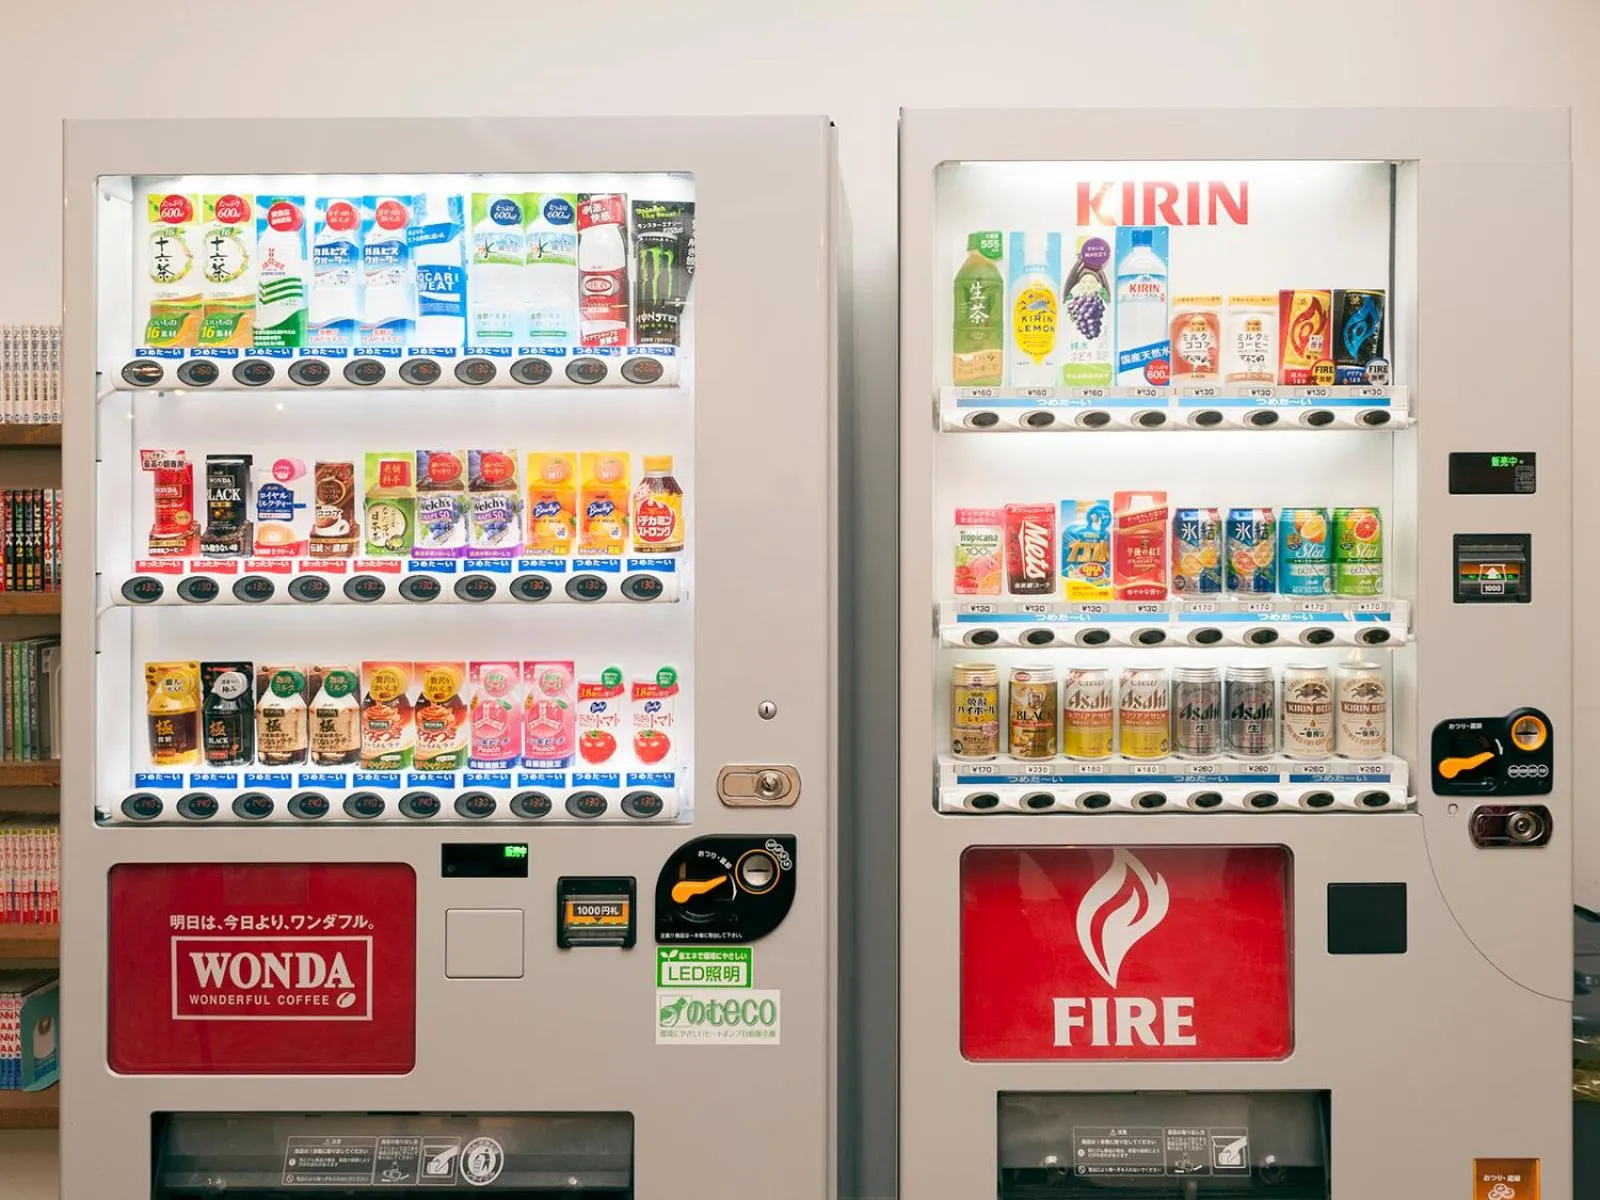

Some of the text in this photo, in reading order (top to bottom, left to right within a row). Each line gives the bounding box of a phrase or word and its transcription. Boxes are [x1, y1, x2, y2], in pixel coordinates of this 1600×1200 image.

[1076, 181, 1249, 225] KIRIN
[981, 240, 1000, 250] 555
[154, 237, 175, 283] 十六茶
[209, 236, 230, 283] 十六茶
[1129, 284, 1160, 293] KIRIN
[969, 281, 989, 324] 生茶
[1021, 314, 1053, 323] KIRIN
[1018, 324, 1055, 333] LEMON
[208, 488, 241, 500] LACK
[637, 516, 672, 526] ドデカミン
[638, 526, 671, 537] ストロング
[960, 531, 998, 542] Tropicana
[1182, 522, 1215, 540] 氷結
[1024, 519, 1049, 579] Mets
[522, 559, 564, 567] つめた〜い
[576, 559, 619, 567] つめた〜い
[630, 559, 672, 567] つめた〜い
[1069, 689, 1112, 709] Asahi
[1122, 689, 1166, 709] Asahi
[958, 706, 994, 715] ハイボール
[1180, 702, 1219, 720] Asahi
[1231, 702, 1272, 720] Asahi
[1288, 704, 1313, 712] KIRIN
[1344, 704, 1370, 712] KIRIN
[577, 906, 620, 916] 1000円札
[170, 914, 375, 931] 明日は、今日より、ワンダフル。
[189, 951, 355, 990] WONDA
[669, 966, 740, 982] LED照明
[189, 994, 330, 1006] WONDERFUL COFFEE
[1053, 997, 1197, 1046] FIRE
